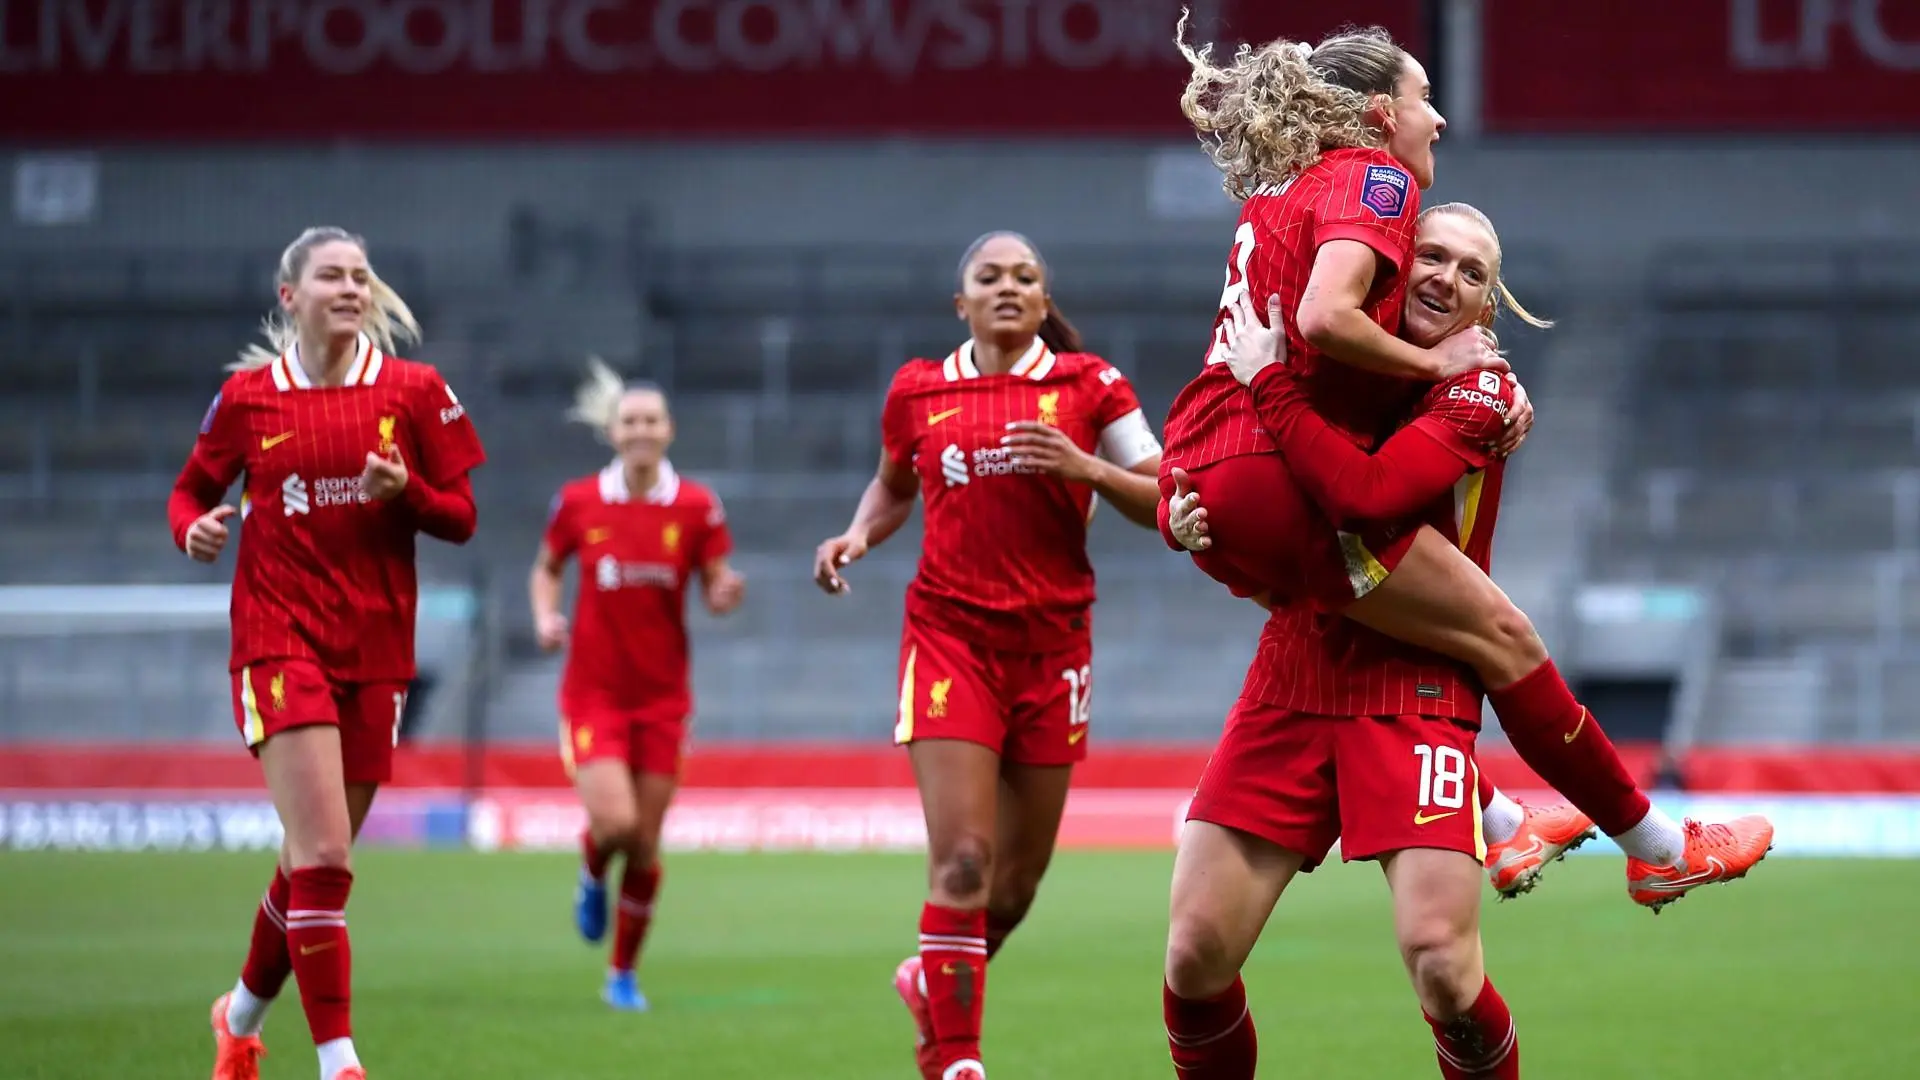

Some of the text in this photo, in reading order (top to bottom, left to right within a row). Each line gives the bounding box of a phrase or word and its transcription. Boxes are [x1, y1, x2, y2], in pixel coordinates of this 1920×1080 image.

[392, 690, 408, 748] 1
[1062, 664, 1092, 725] 12
[1414, 744, 1466, 809] 18
